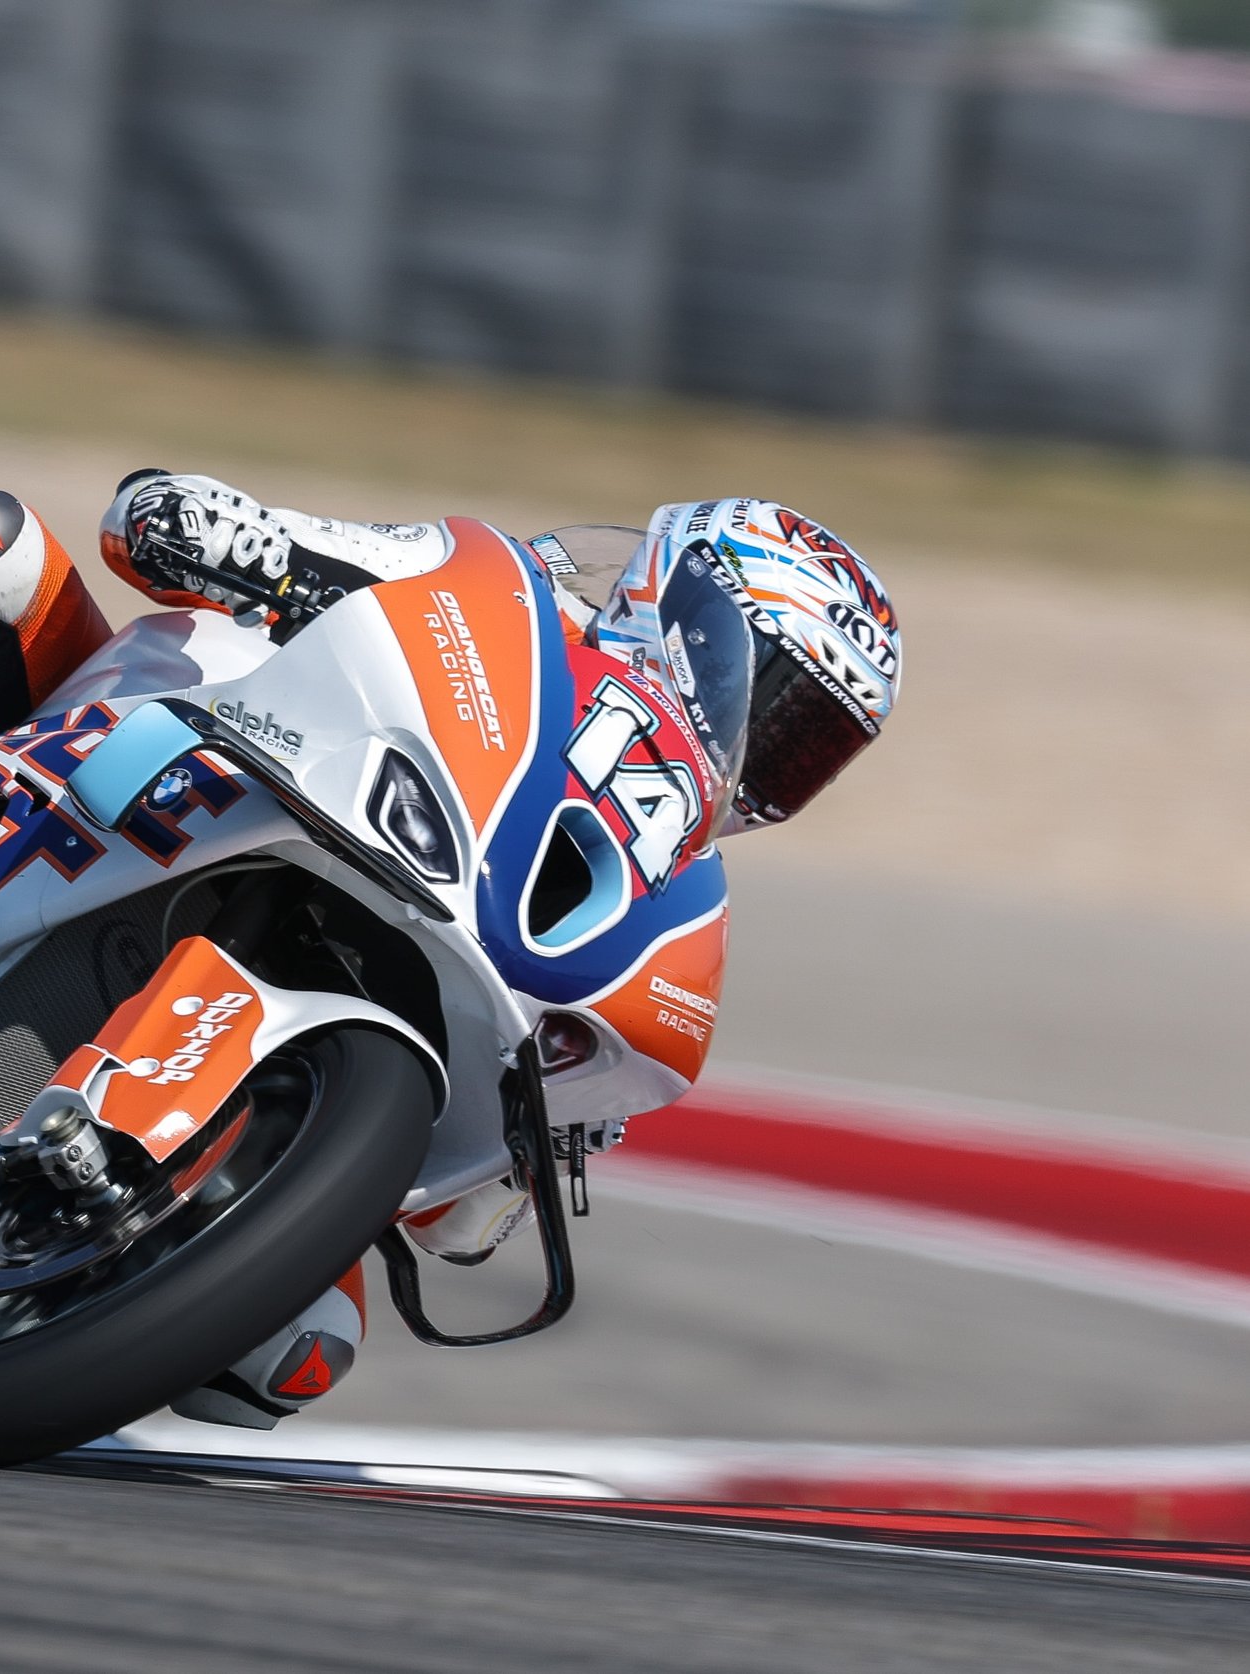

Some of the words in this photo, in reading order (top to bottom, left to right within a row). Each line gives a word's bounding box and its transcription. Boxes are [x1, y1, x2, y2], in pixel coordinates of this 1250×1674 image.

[423, 613, 474, 721] RACING
[832, 603, 897, 669] KYT
[217, 701, 304, 748] alpha
[248, 731, 299, 756] RACING
[560, 673, 703, 899] 14
[147, 992, 253, 1085] DUNLOP
[656, 1009, 706, 1042] RACING
